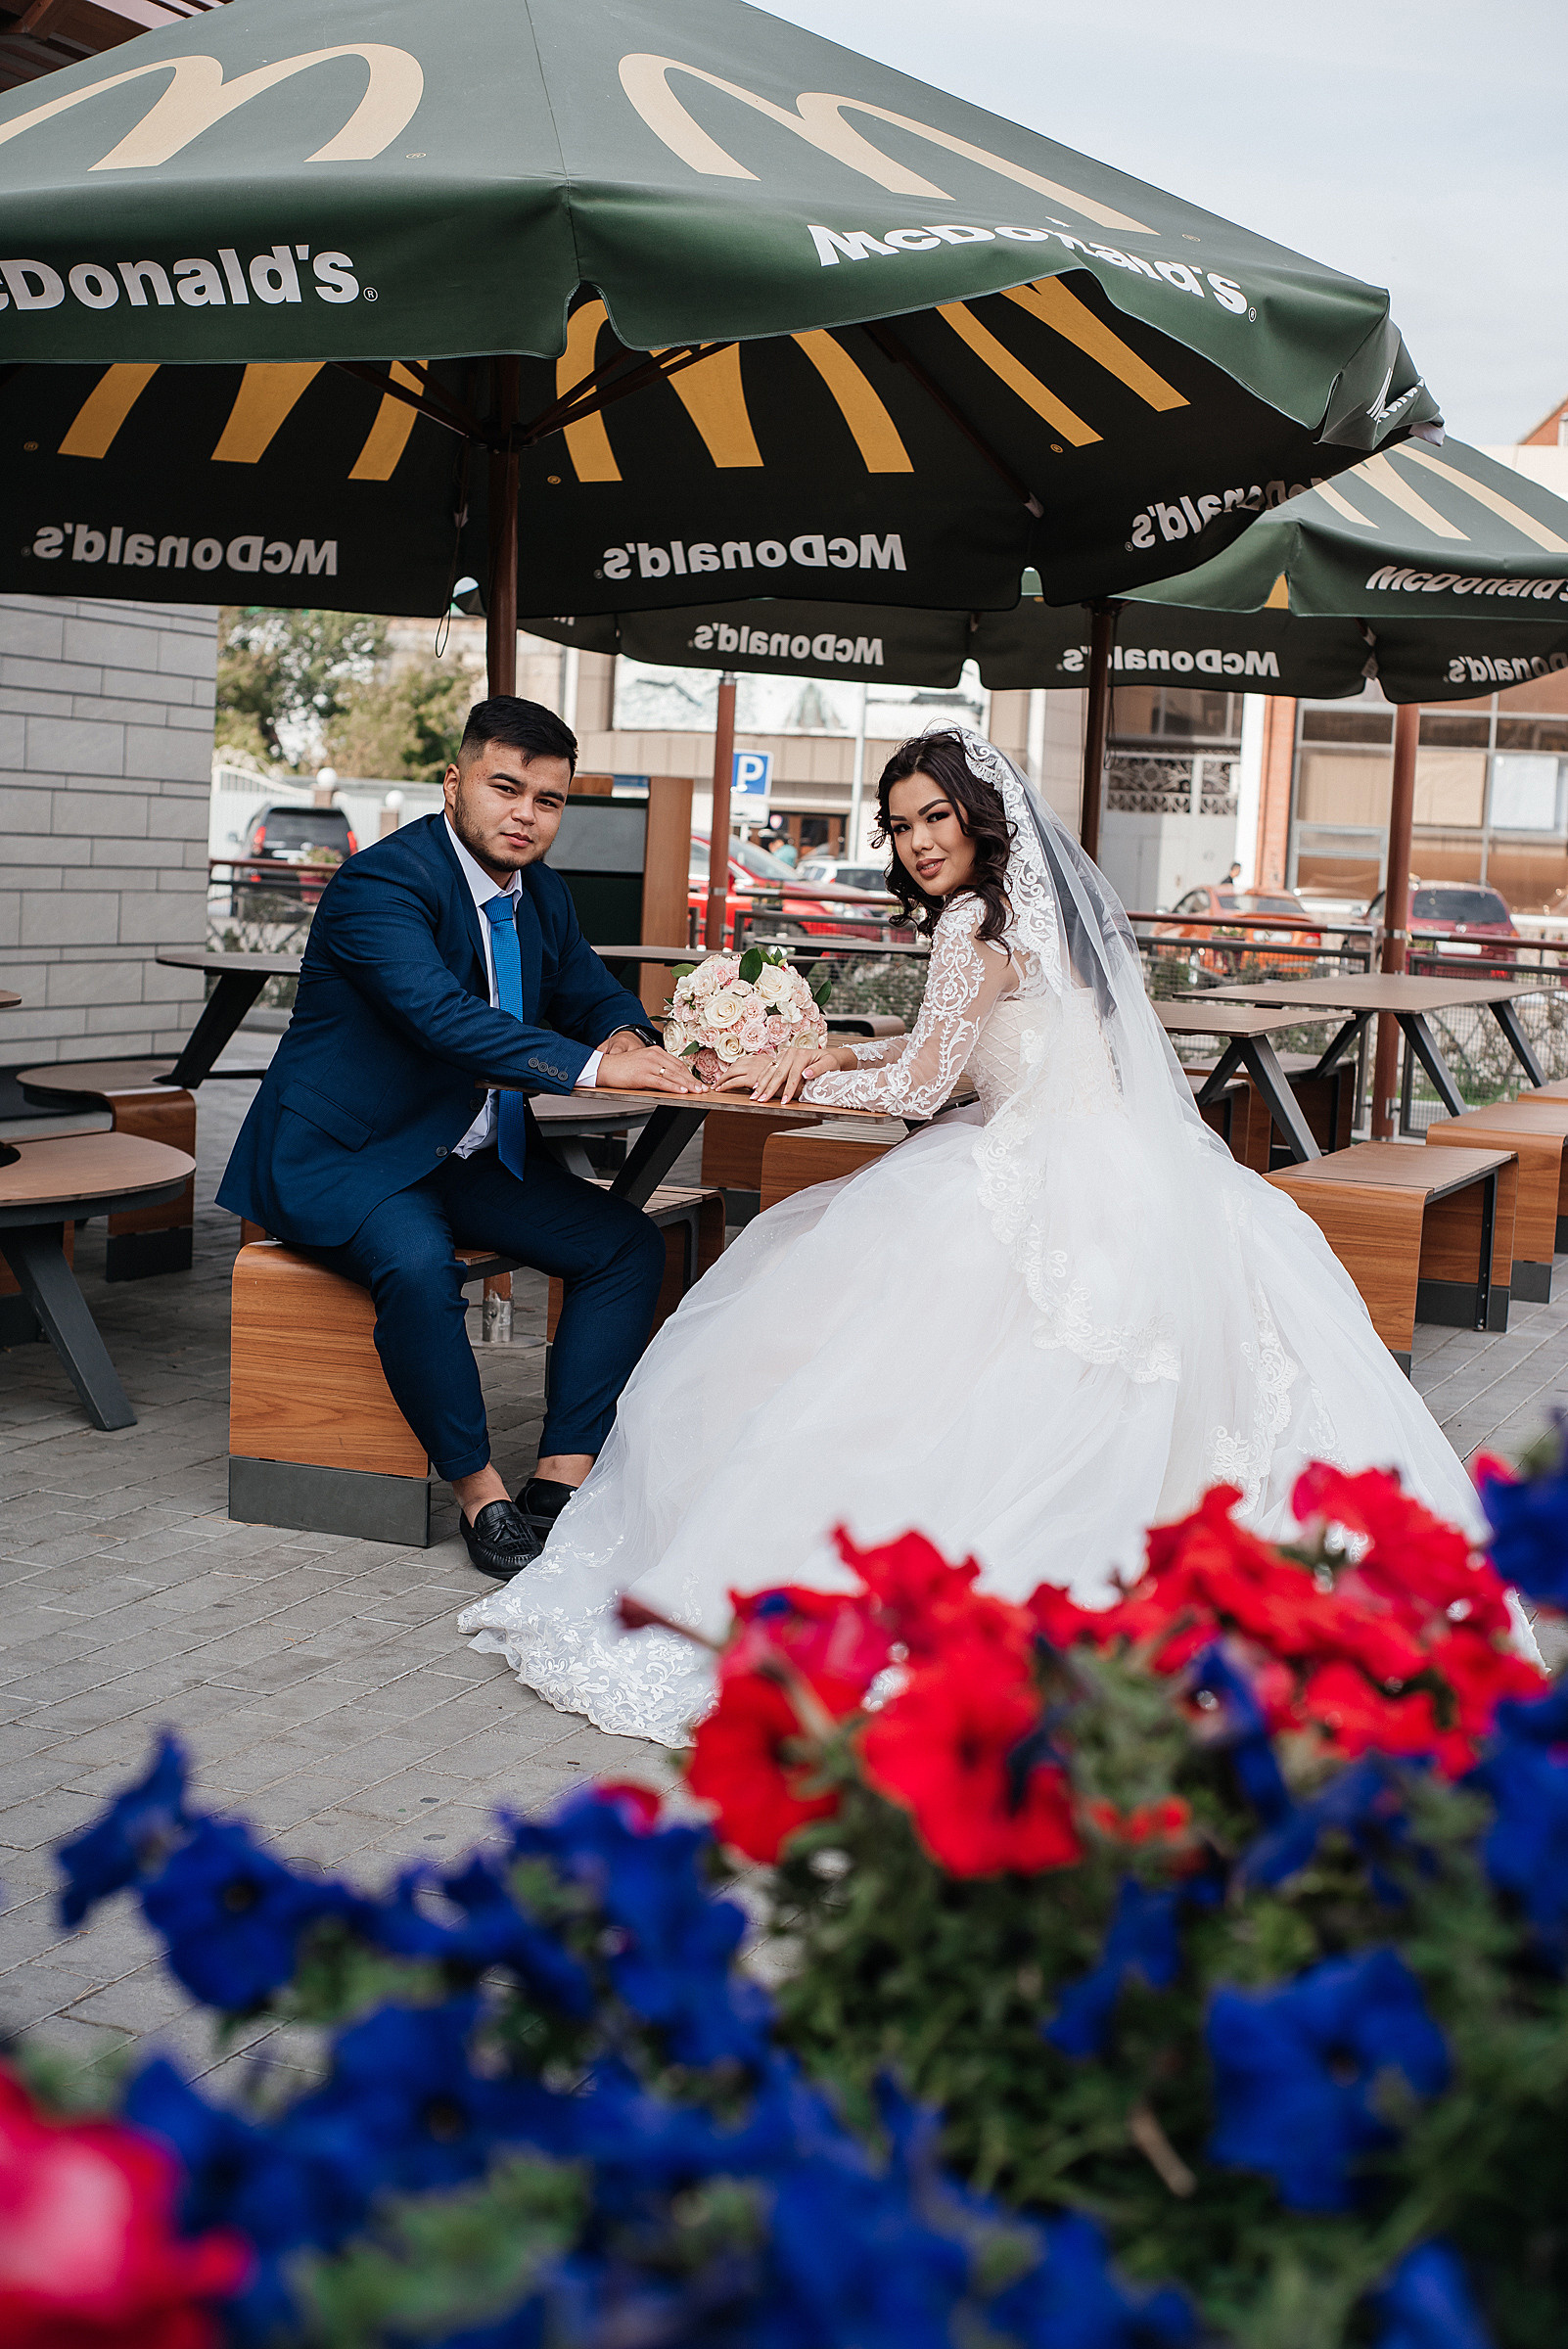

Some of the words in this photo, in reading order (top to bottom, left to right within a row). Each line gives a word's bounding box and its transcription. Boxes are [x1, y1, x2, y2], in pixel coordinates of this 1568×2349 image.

[0, 244, 360, 311] Donald's
[807, 215, 1249, 316] McDonald's
[1364, 565, 1568, 603] McDonald
[736, 755, 765, 791] P
